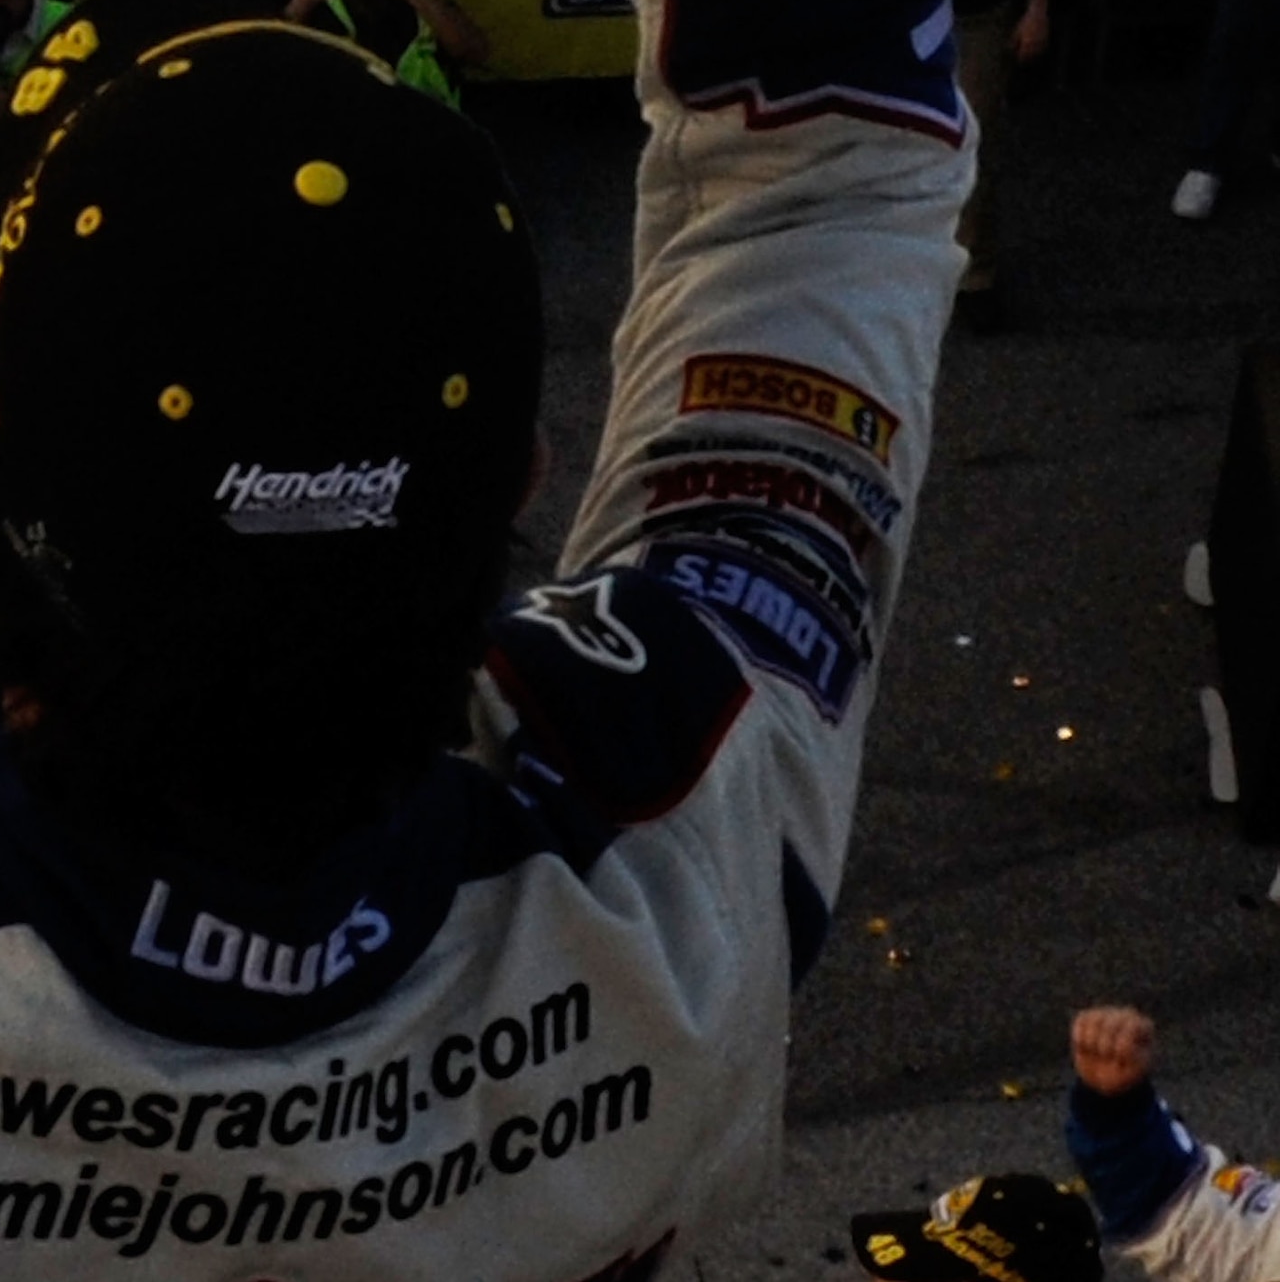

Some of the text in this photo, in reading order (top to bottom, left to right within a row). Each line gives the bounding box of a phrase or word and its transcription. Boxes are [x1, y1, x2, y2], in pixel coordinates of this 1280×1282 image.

[705, 367, 838, 417] BOSCH
[212, 455, 411, 511] Hendrick
[672, 553, 838, 692] LOWE'S
[129, 878, 395, 997] LOWE'S
